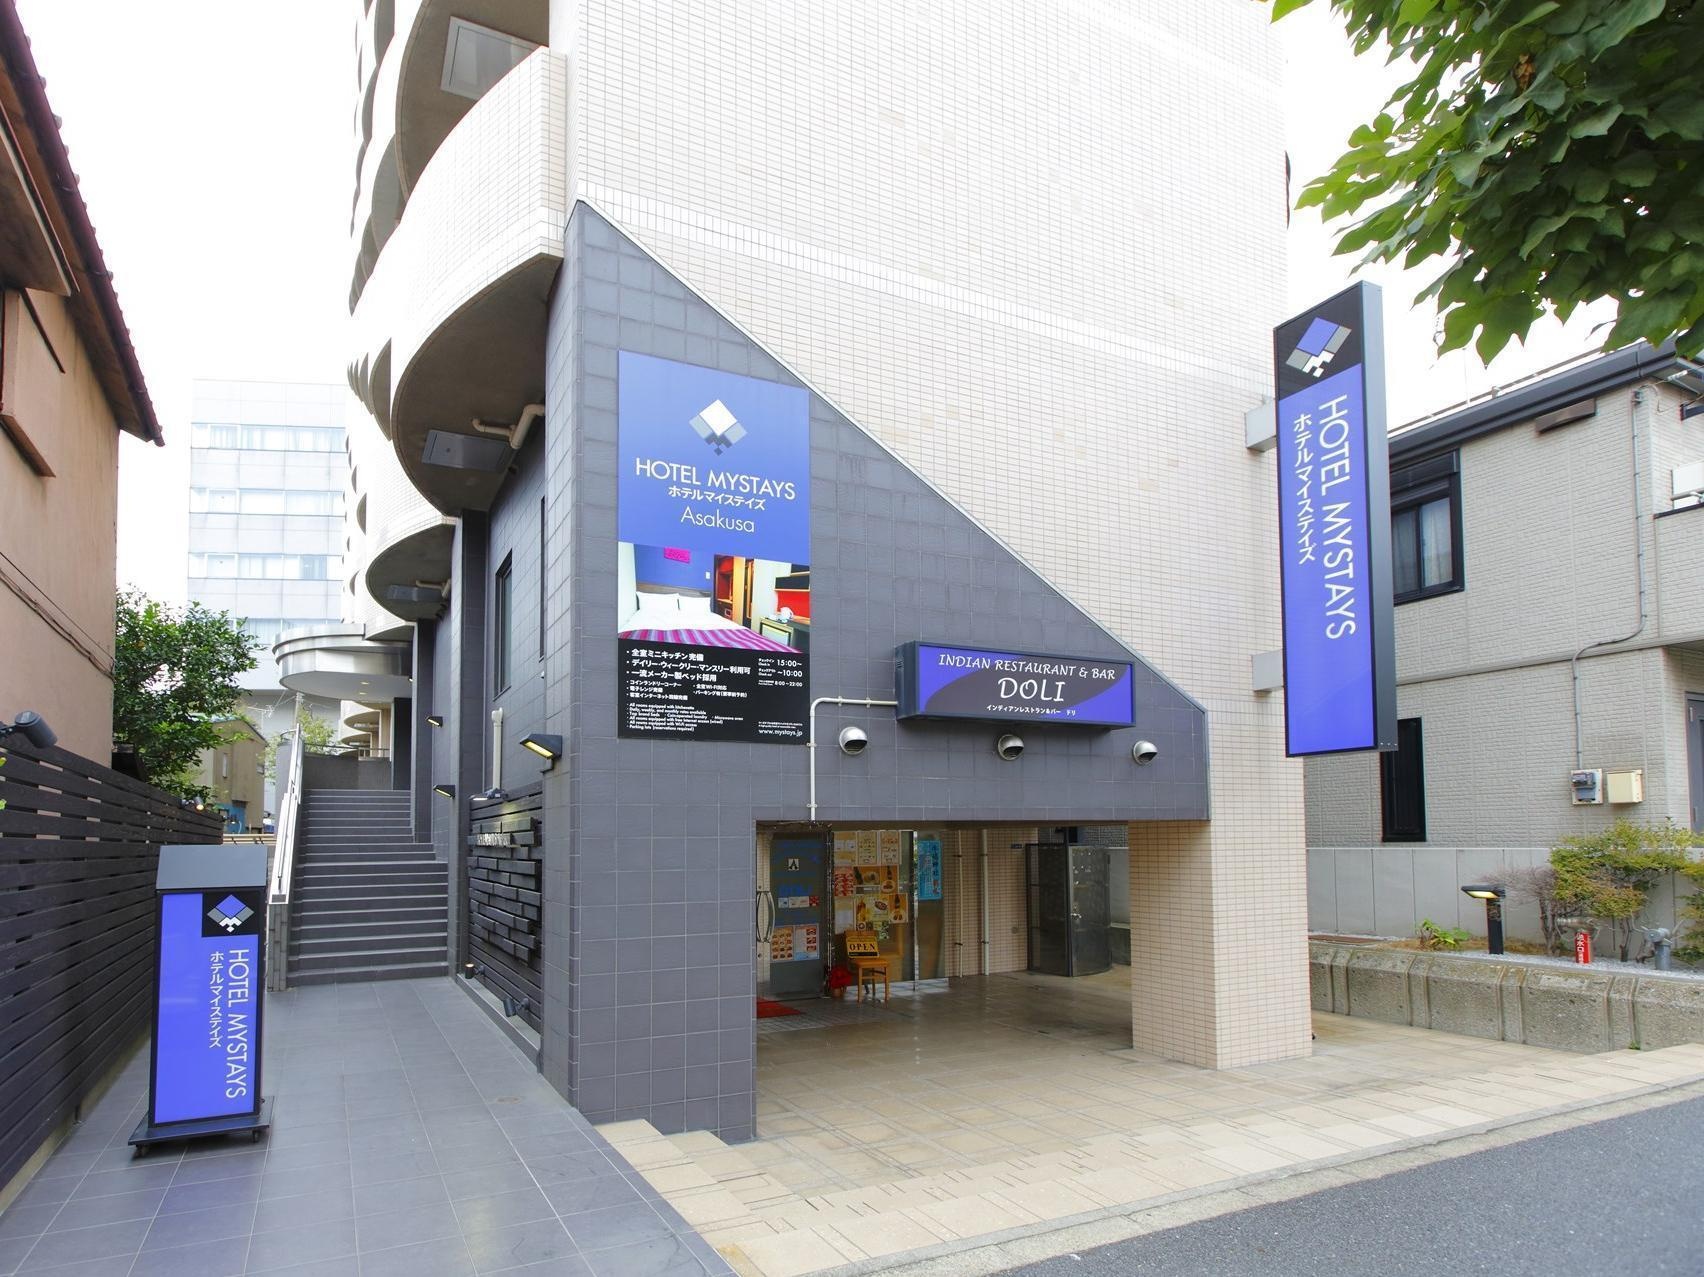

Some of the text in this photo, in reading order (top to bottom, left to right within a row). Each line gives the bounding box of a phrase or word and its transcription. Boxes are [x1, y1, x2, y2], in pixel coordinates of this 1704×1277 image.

[636, 458, 796, 500] HOTEL MYSTAYS
[668, 485, 766, 510] ホテルマイステイズ
[1293, 412, 1318, 565] ホテルマイステイズ
[680, 506, 755, 532] Asakusa
[1318, 394, 1356, 640] HOTEL MYSTAYS
[938, 654, 1116, 680] INDIAN RESTAURANT & BAR
[998, 678, 1066, 702] DOLI
[210, 951, 224, 1048] ホテルマイステイズ
[226, 948, 250, 1099] HOTEL MYSTAYS
